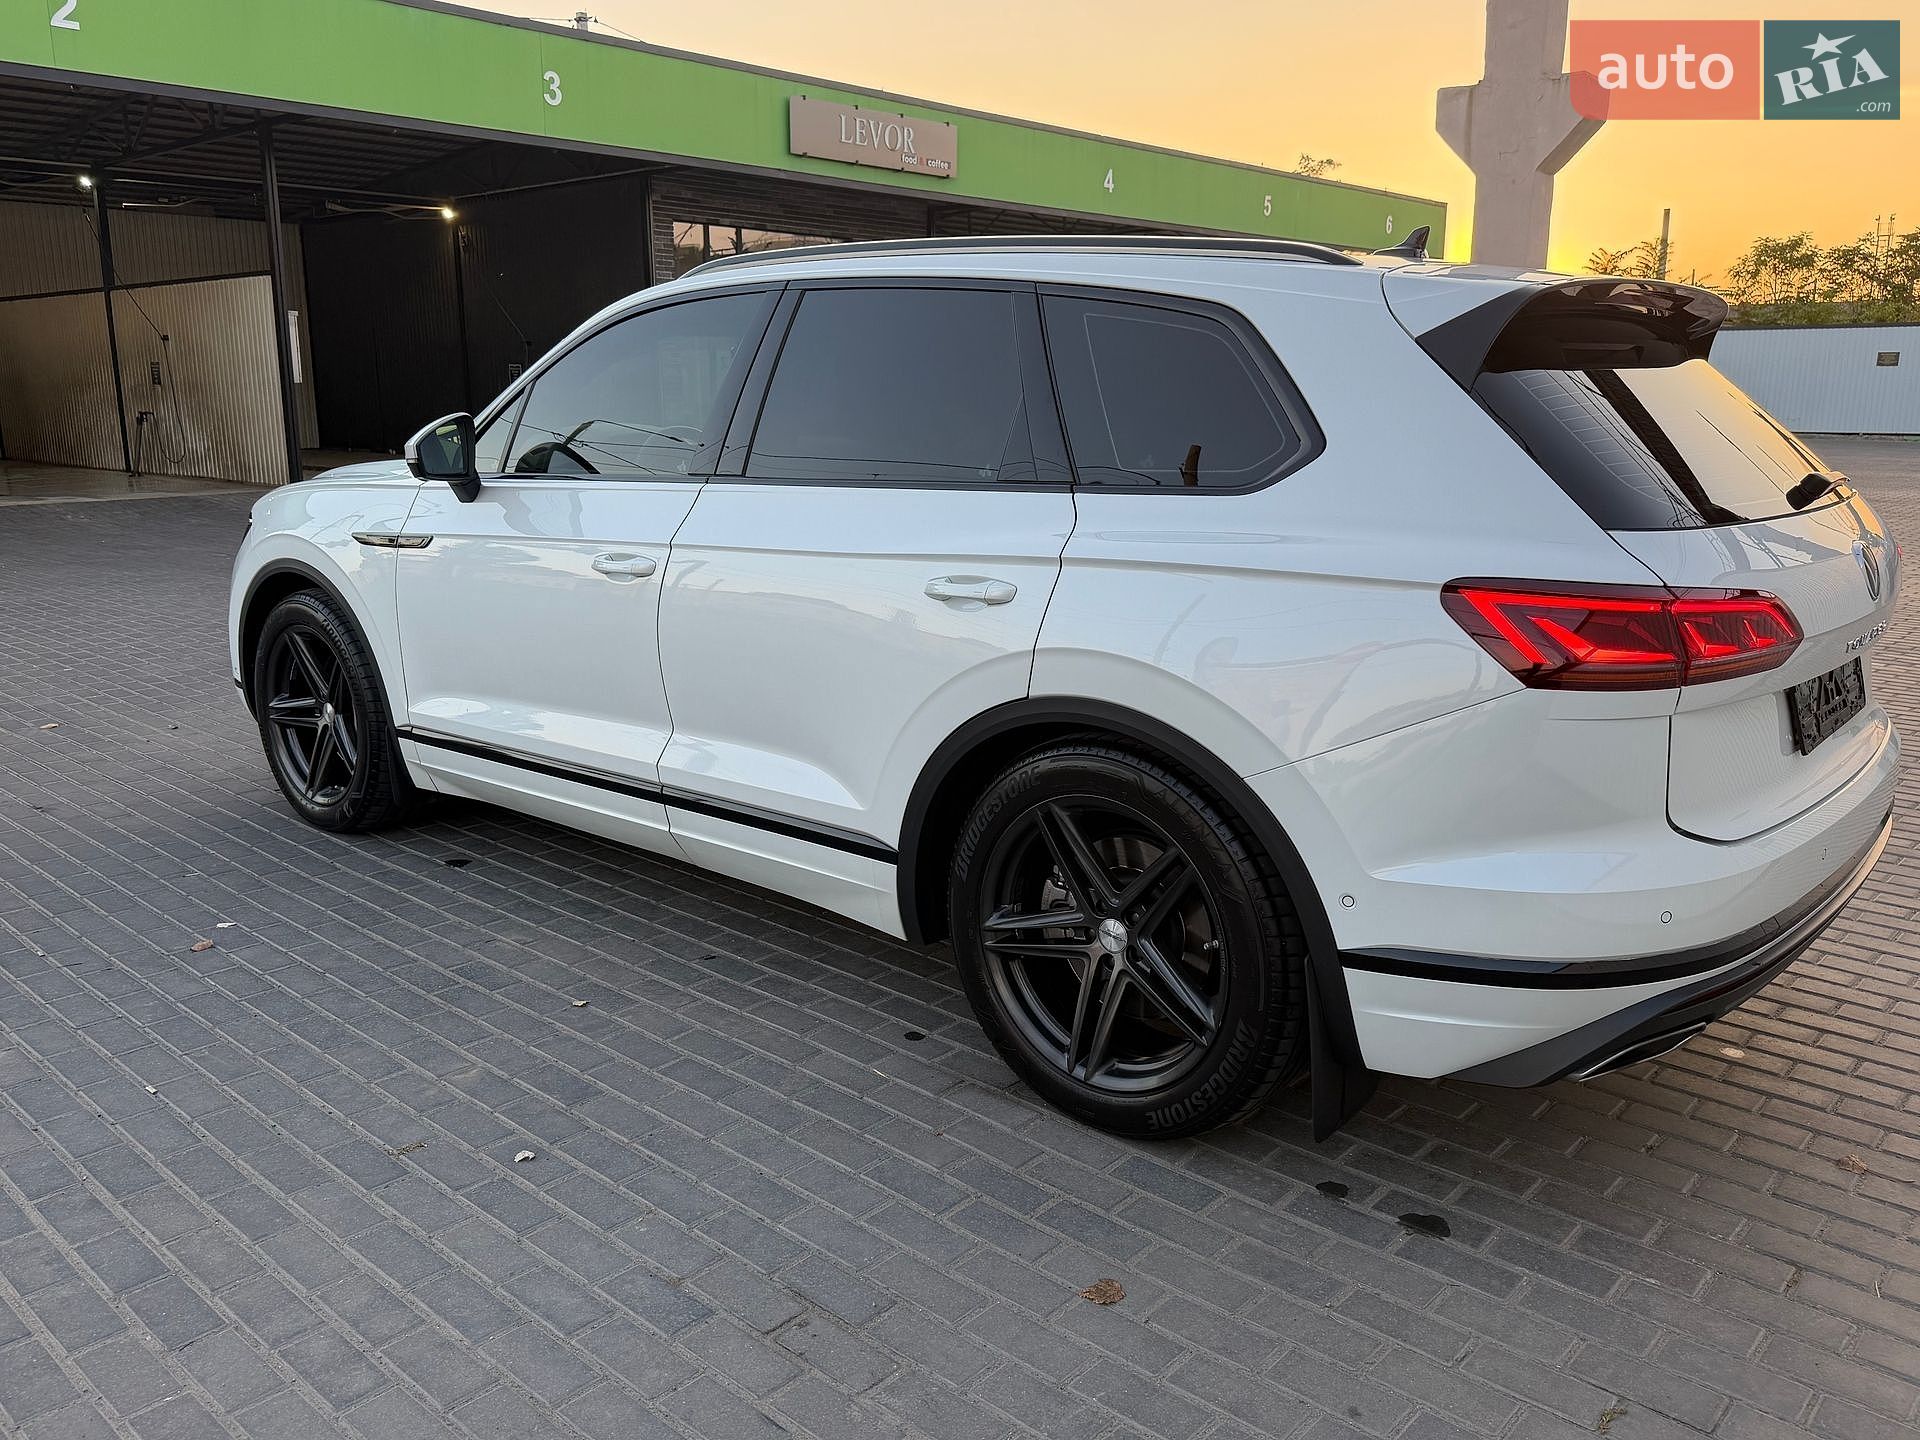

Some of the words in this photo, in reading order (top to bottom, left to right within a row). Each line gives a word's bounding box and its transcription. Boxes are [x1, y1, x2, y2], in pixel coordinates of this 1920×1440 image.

[50, 0, 80, 30] 2
[543, 70, 563, 106] 3
[839, 112, 915, 154] LEVOR
[901, 152, 919, 165] food
[926, 158, 951, 170] coffee
[1103, 168, 1115, 193] 4
[1263, 194, 1272, 217] 5
[1385, 215, 1393, 234] 6
[955, 766, 1043, 883] BRIDGESTONE
[1144, 1017, 1258, 1131] BRIDGESTONE
